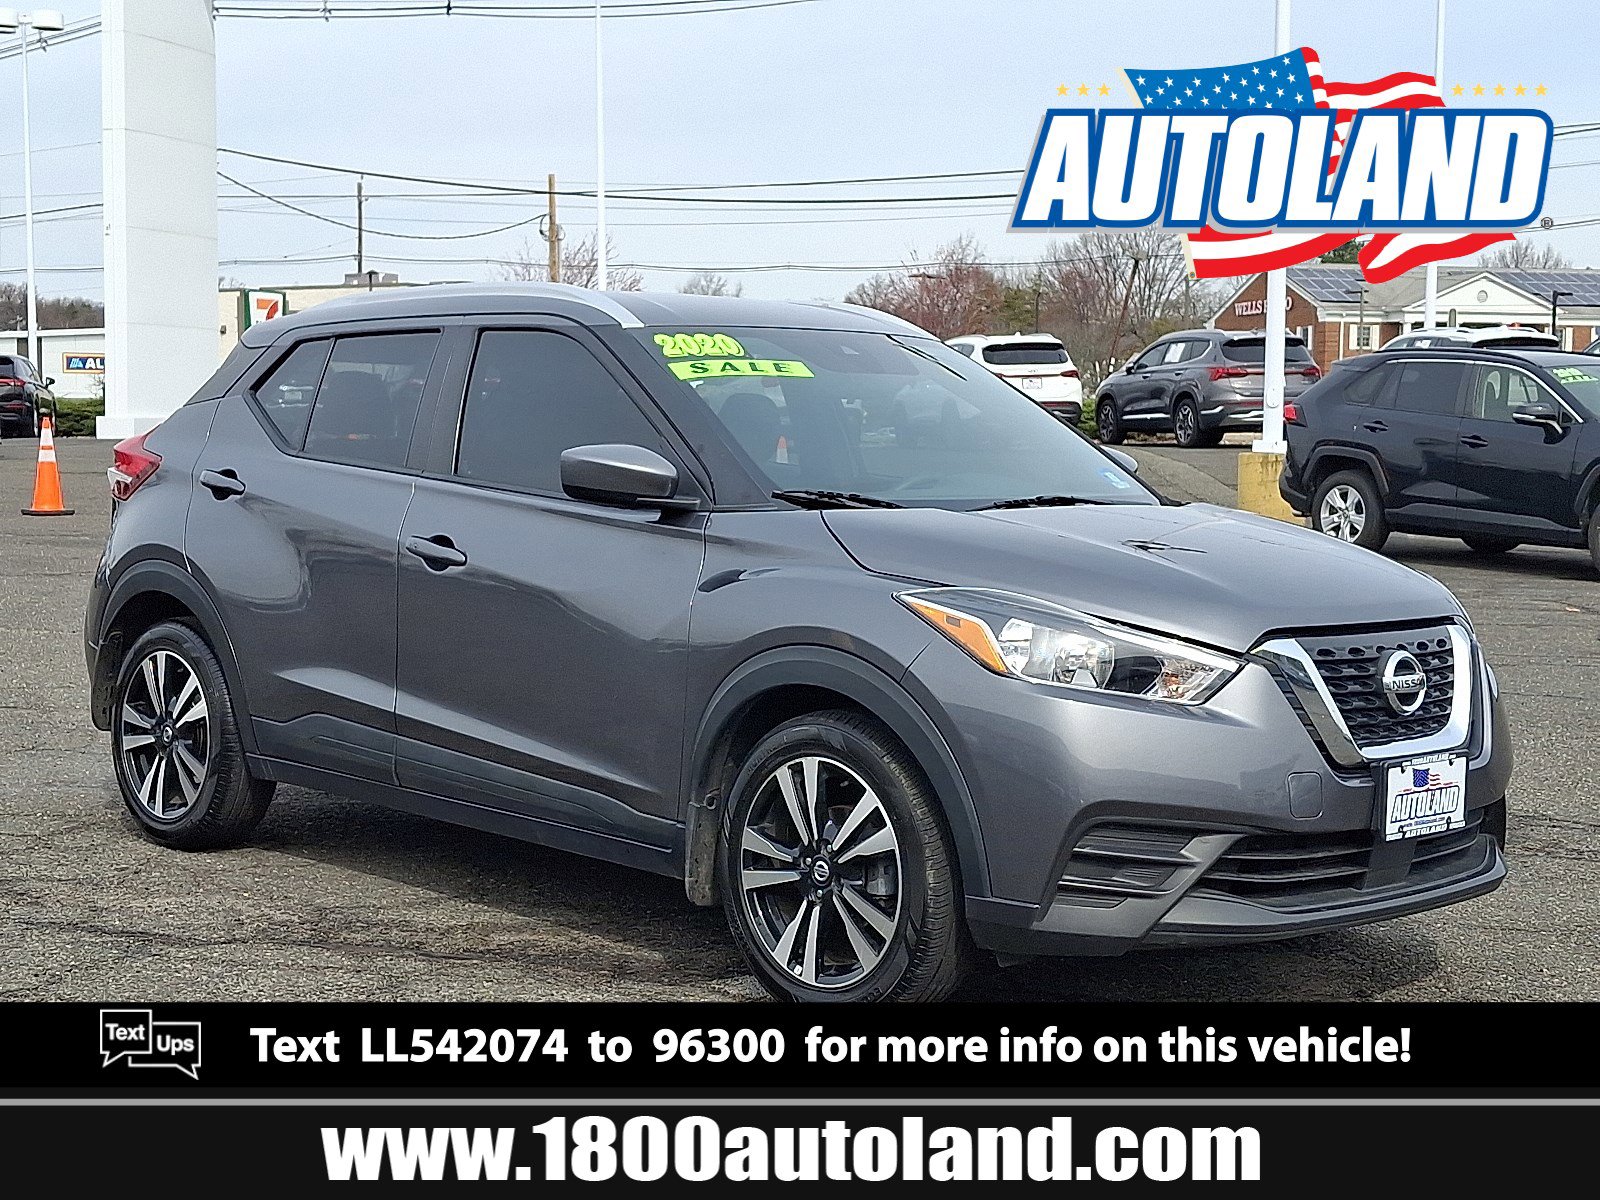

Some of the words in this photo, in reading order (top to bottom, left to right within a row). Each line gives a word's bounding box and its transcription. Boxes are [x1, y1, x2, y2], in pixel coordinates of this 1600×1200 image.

[1235, 300, 1263, 317] WELLS
[653, 333, 745, 358] 2020
[85, 357, 105, 370] AL
[689, 361, 792, 374] SALE
[1391, 786, 1459, 823] AUTOLAND
